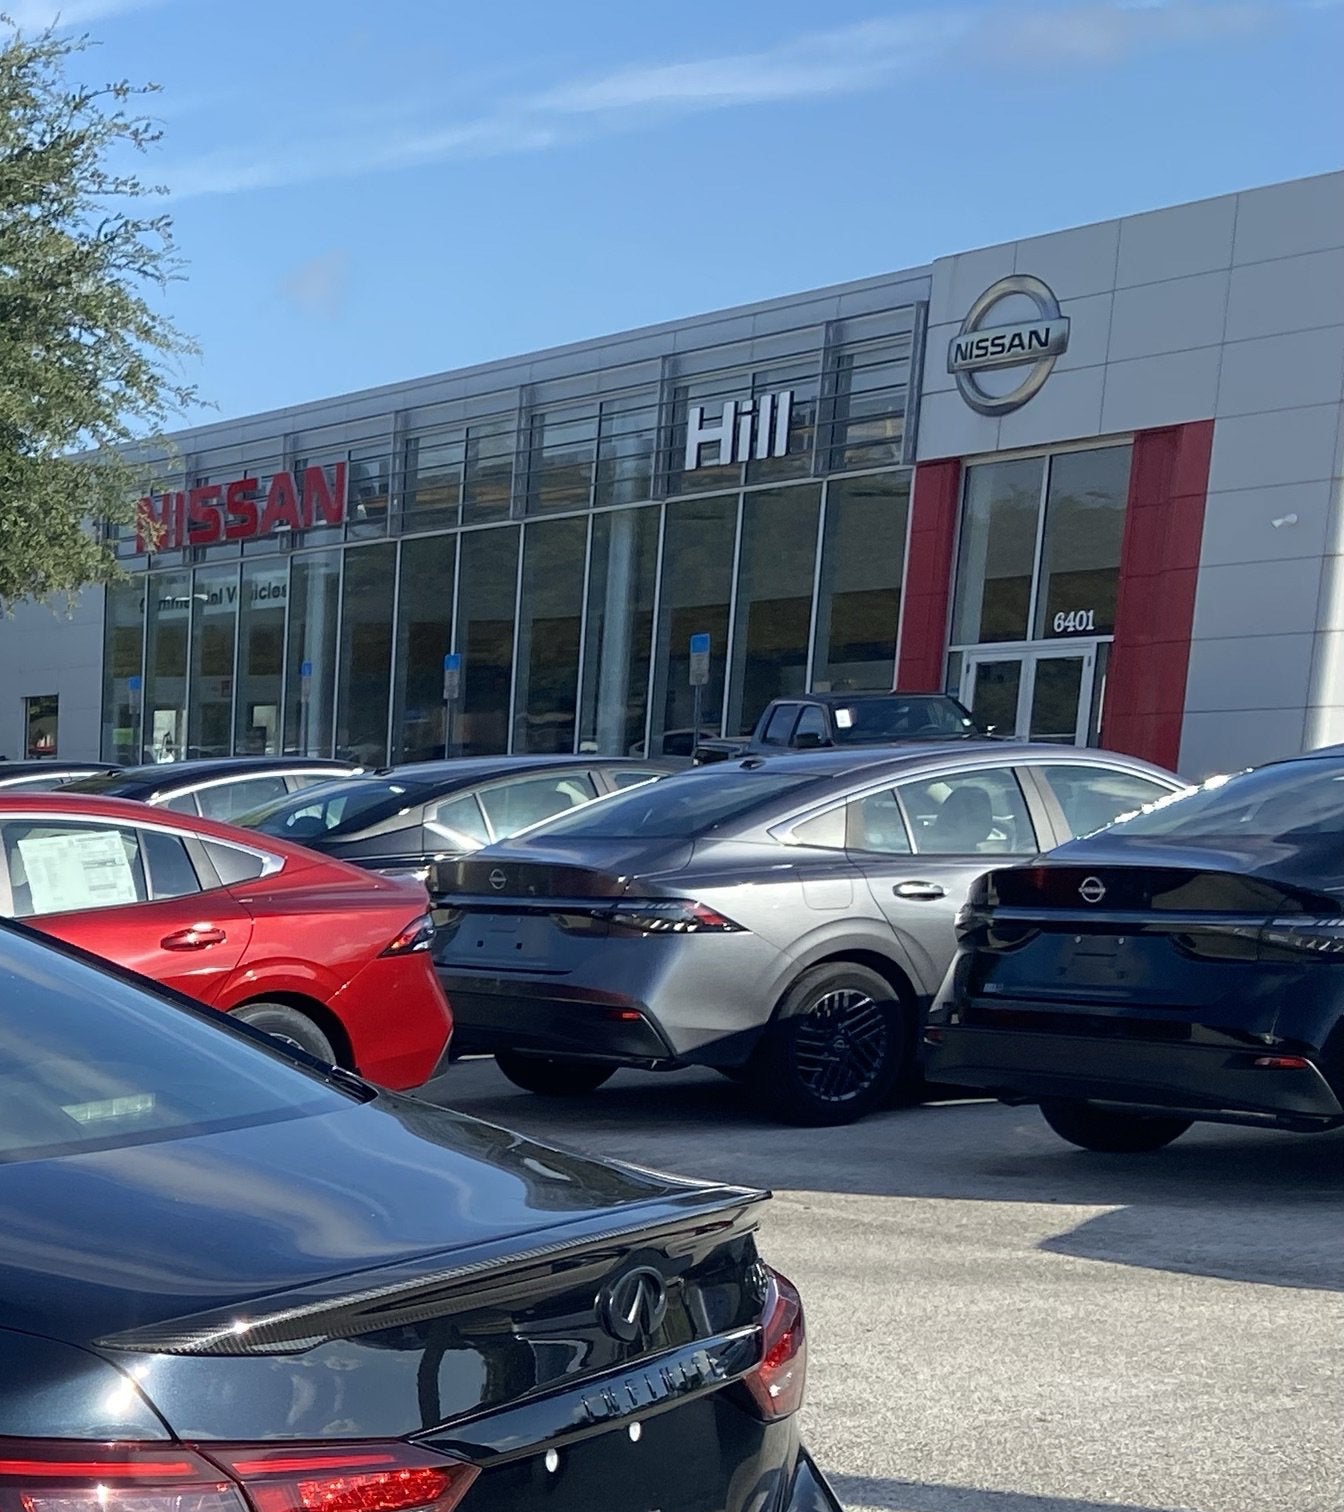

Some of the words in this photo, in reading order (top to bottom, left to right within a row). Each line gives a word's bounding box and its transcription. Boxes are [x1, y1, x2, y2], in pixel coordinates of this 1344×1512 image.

[954, 327, 1050, 363] NISSAN
[685, 390, 793, 471] Hill
[136, 461, 346, 555] NISSAN
[1053, 609, 1094, 632] 6401
